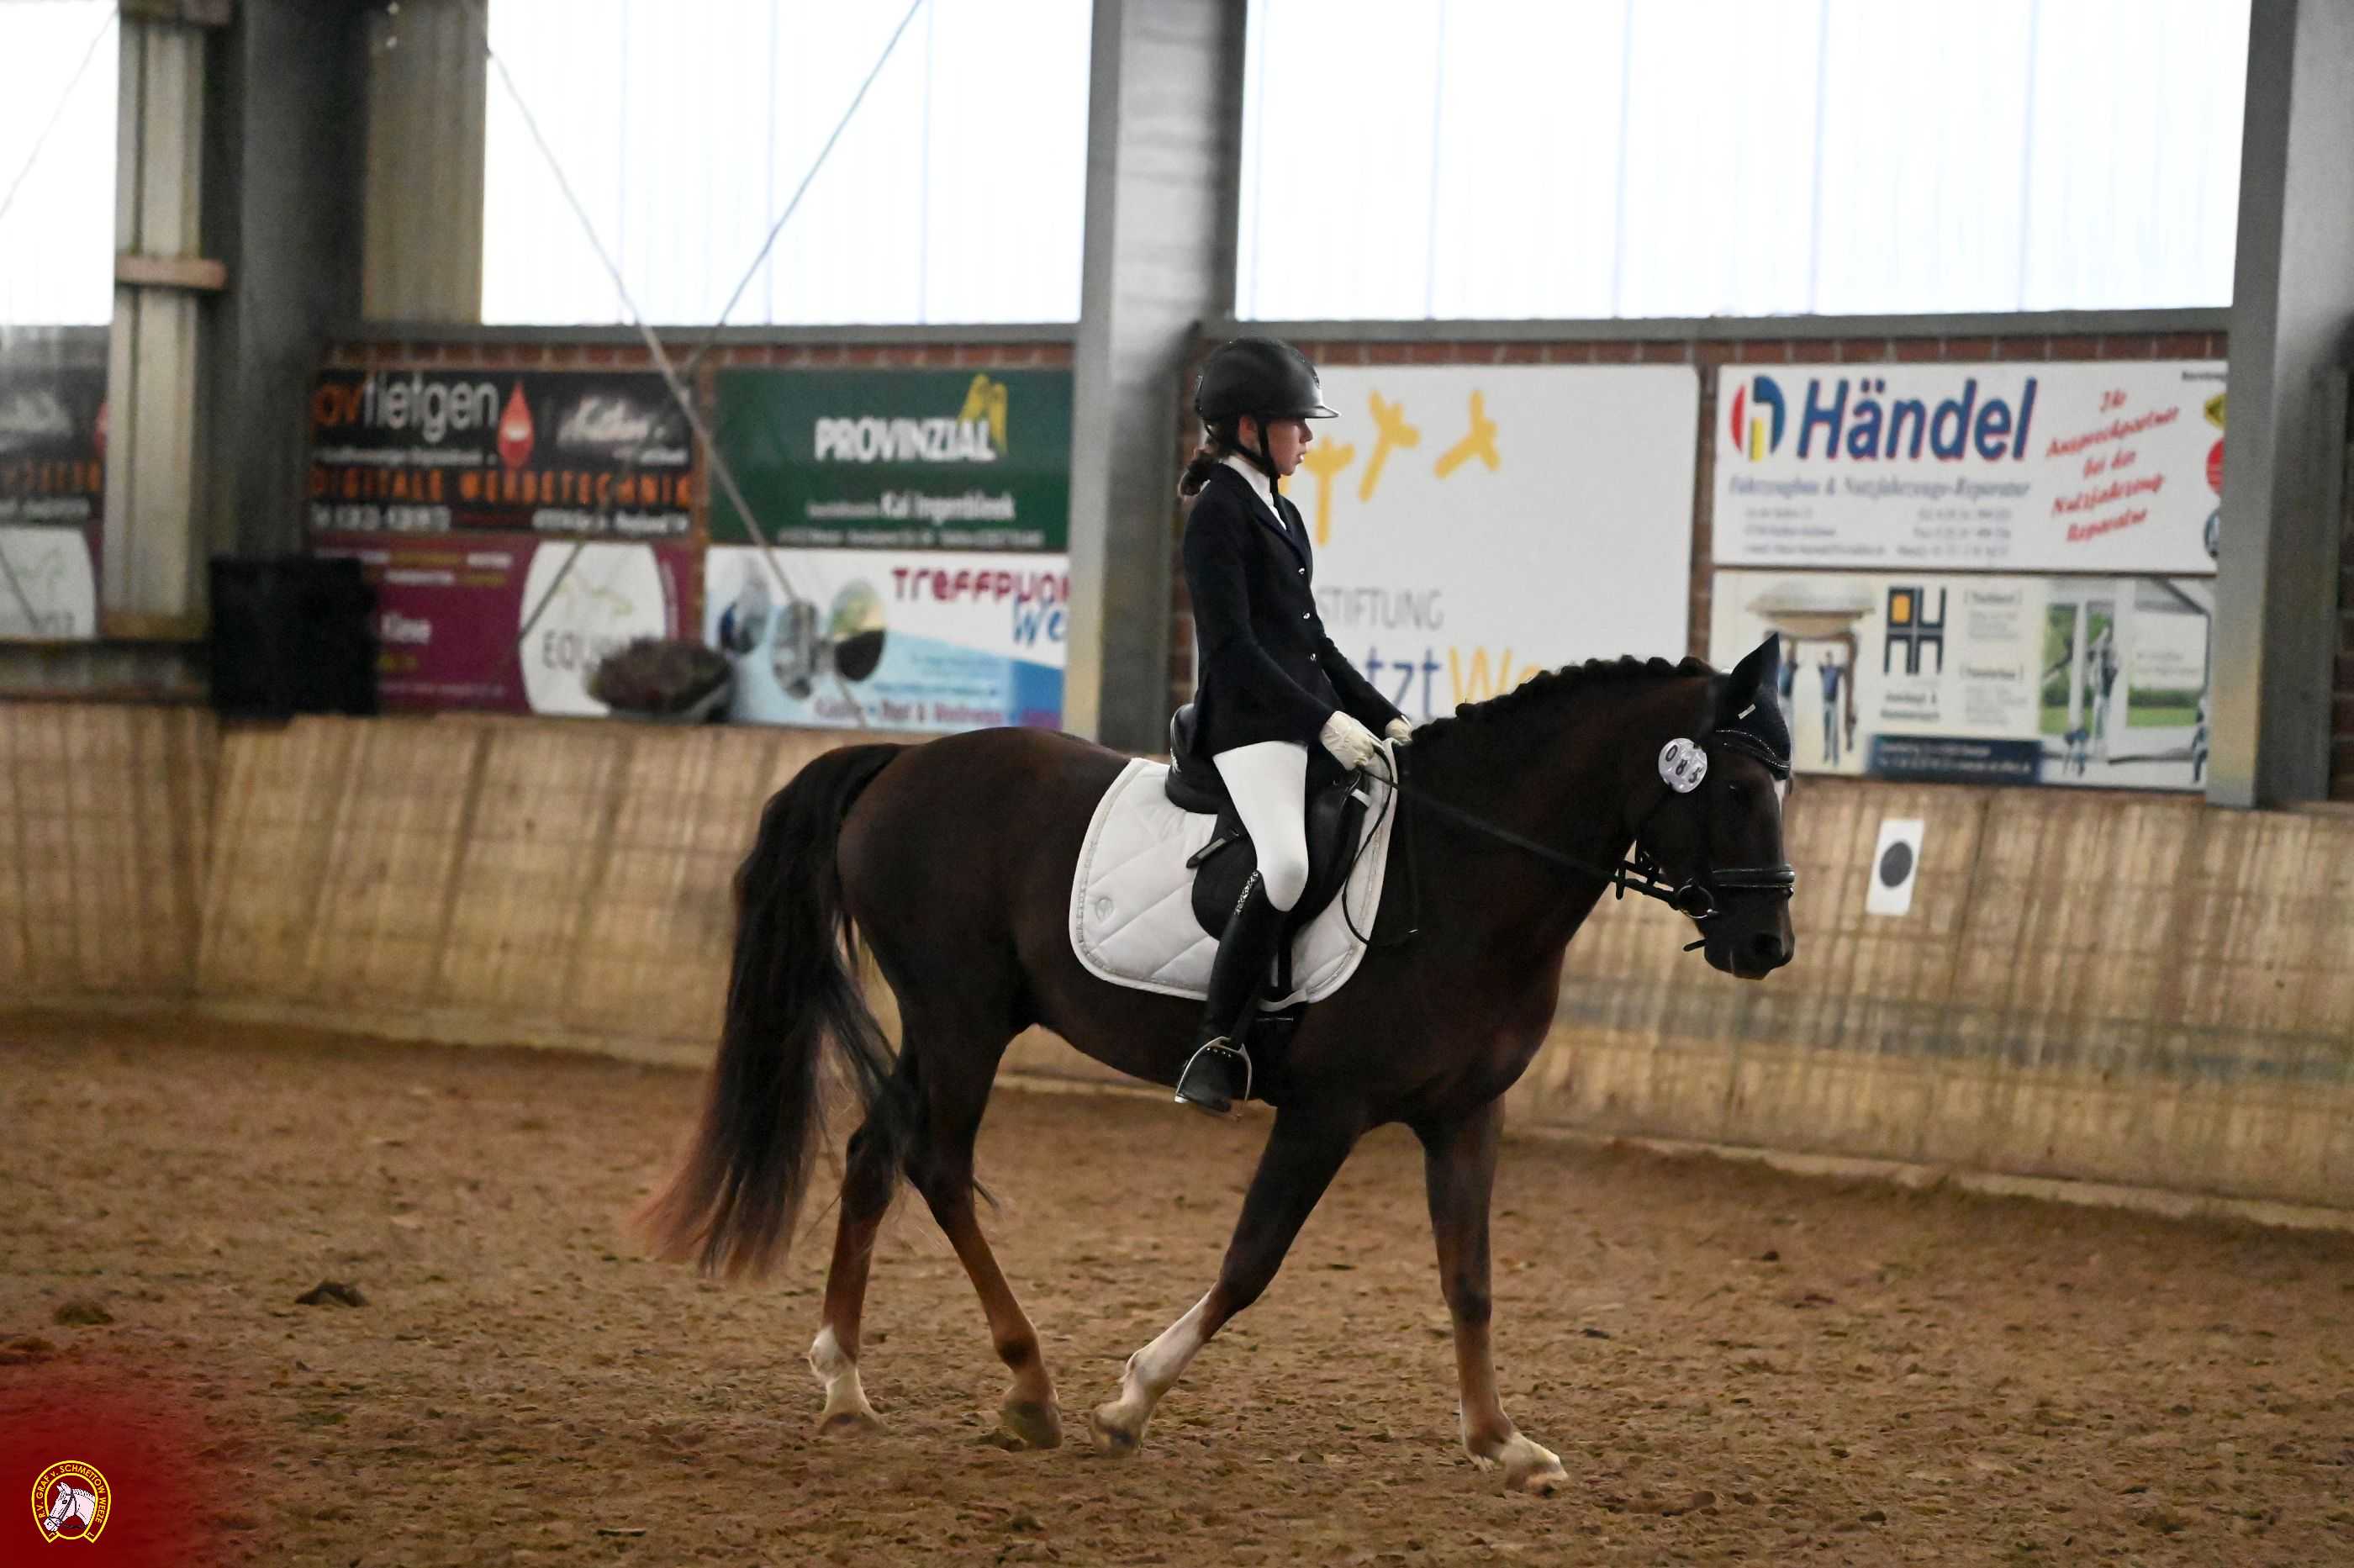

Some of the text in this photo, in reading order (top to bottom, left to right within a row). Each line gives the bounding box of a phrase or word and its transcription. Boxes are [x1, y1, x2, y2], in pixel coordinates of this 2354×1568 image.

[814, 415, 996, 463] PROVINZIAL
[1796, 377, 2038, 462] Händel
[1317, 587, 1444, 631] STIFTUNG
